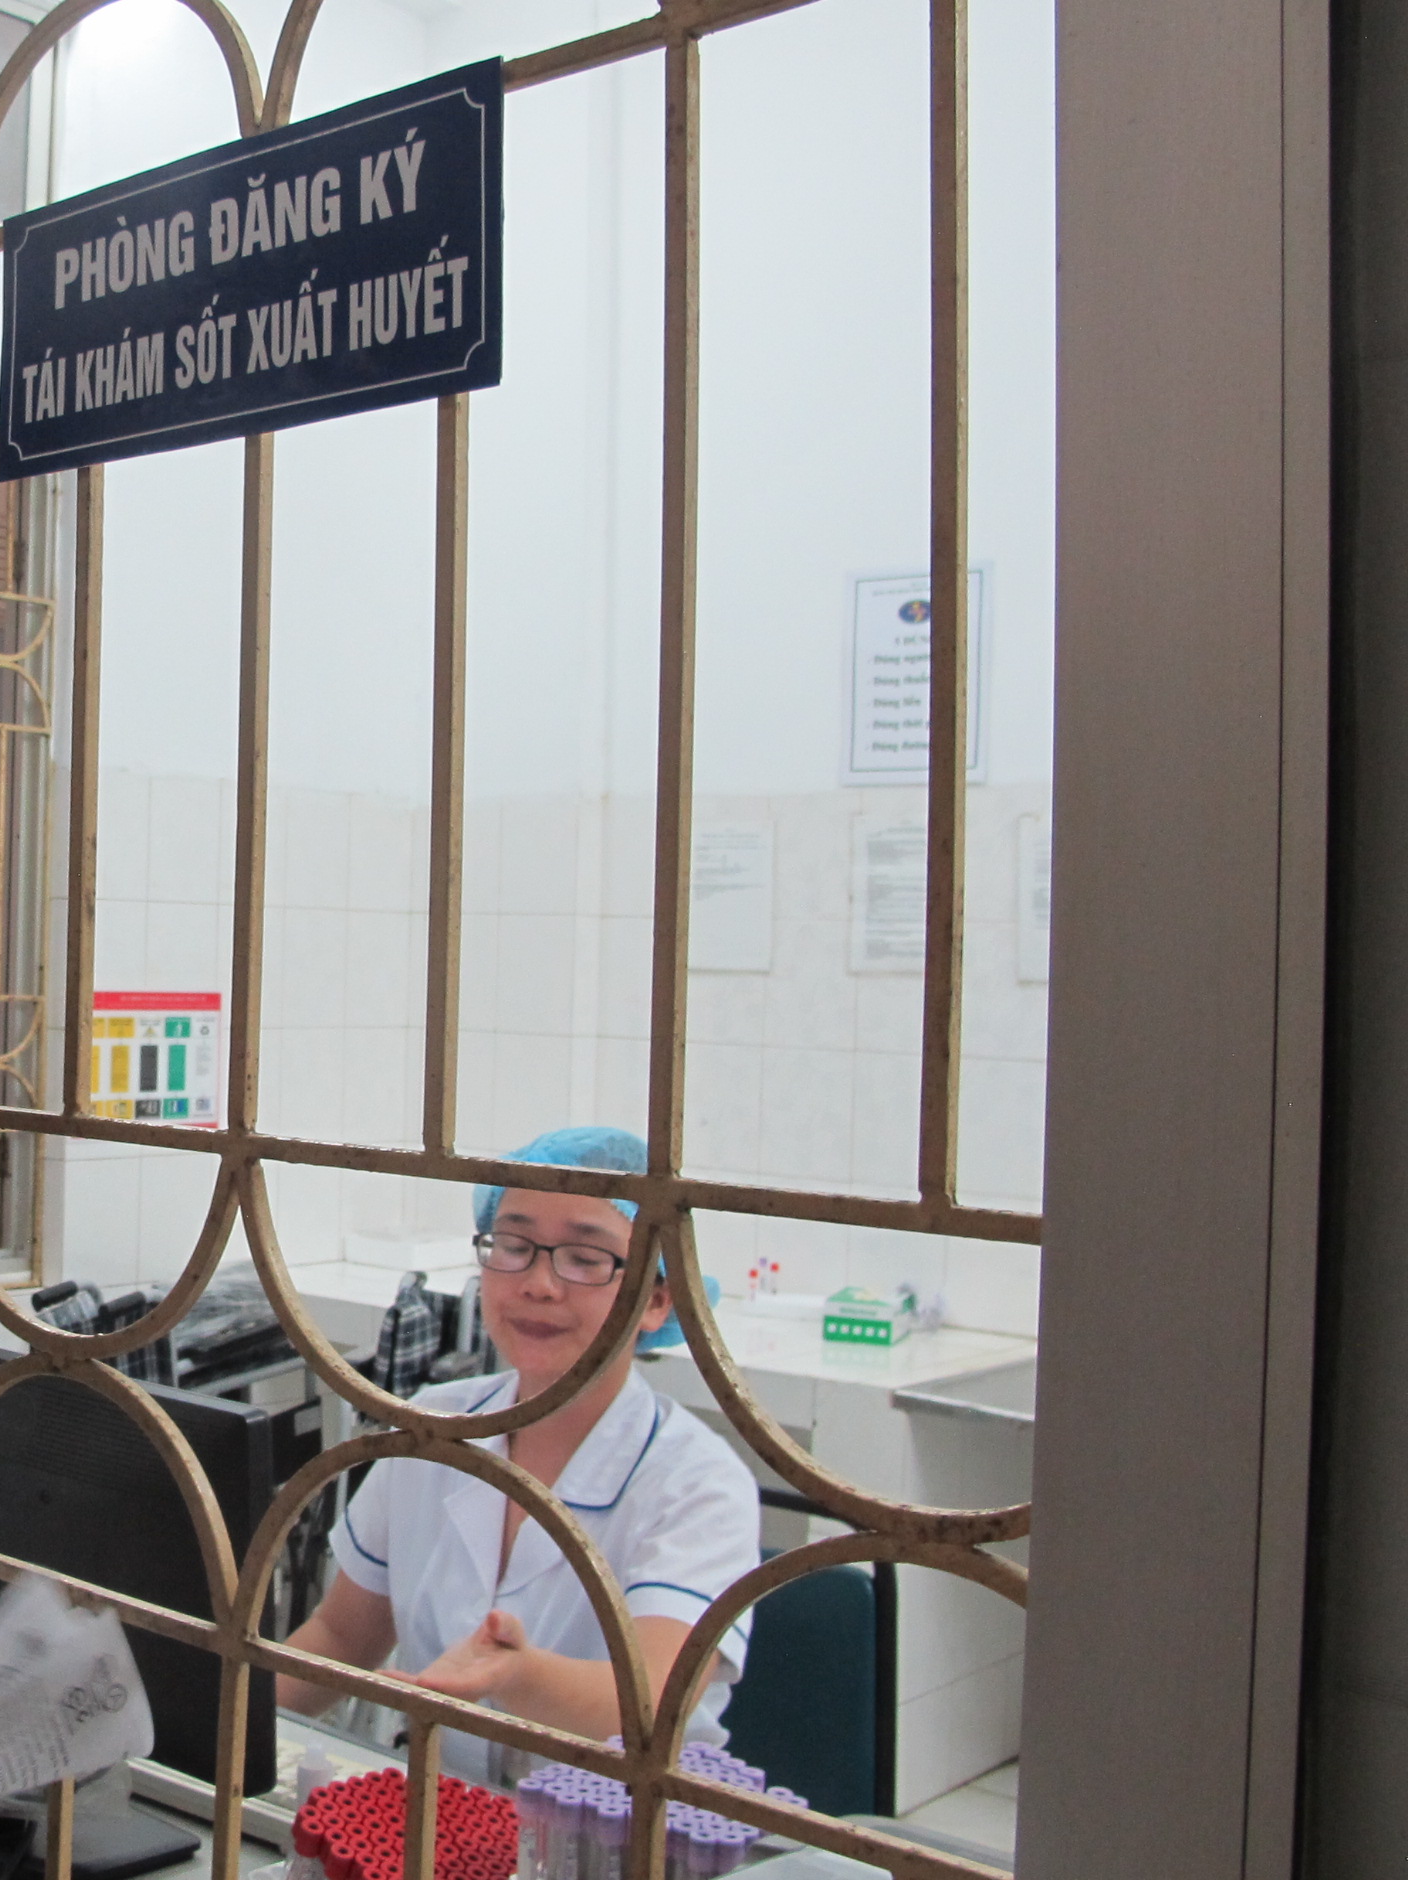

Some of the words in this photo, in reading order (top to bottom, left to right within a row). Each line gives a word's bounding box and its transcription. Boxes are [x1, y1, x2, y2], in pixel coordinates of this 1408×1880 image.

[53, 211, 195, 310] PHÒNG
[208, 166, 341, 266] ĐĂNG
[359, 127, 427, 226] KÝ
[22, 346, 66, 424] TÁI
[74, 327, 165, 412] KHÁM
[174, 294, 238, 390] SỐT
[245, 268, 338, 374] XUẤT
[348, 234, 470, 352] HUYẾT
